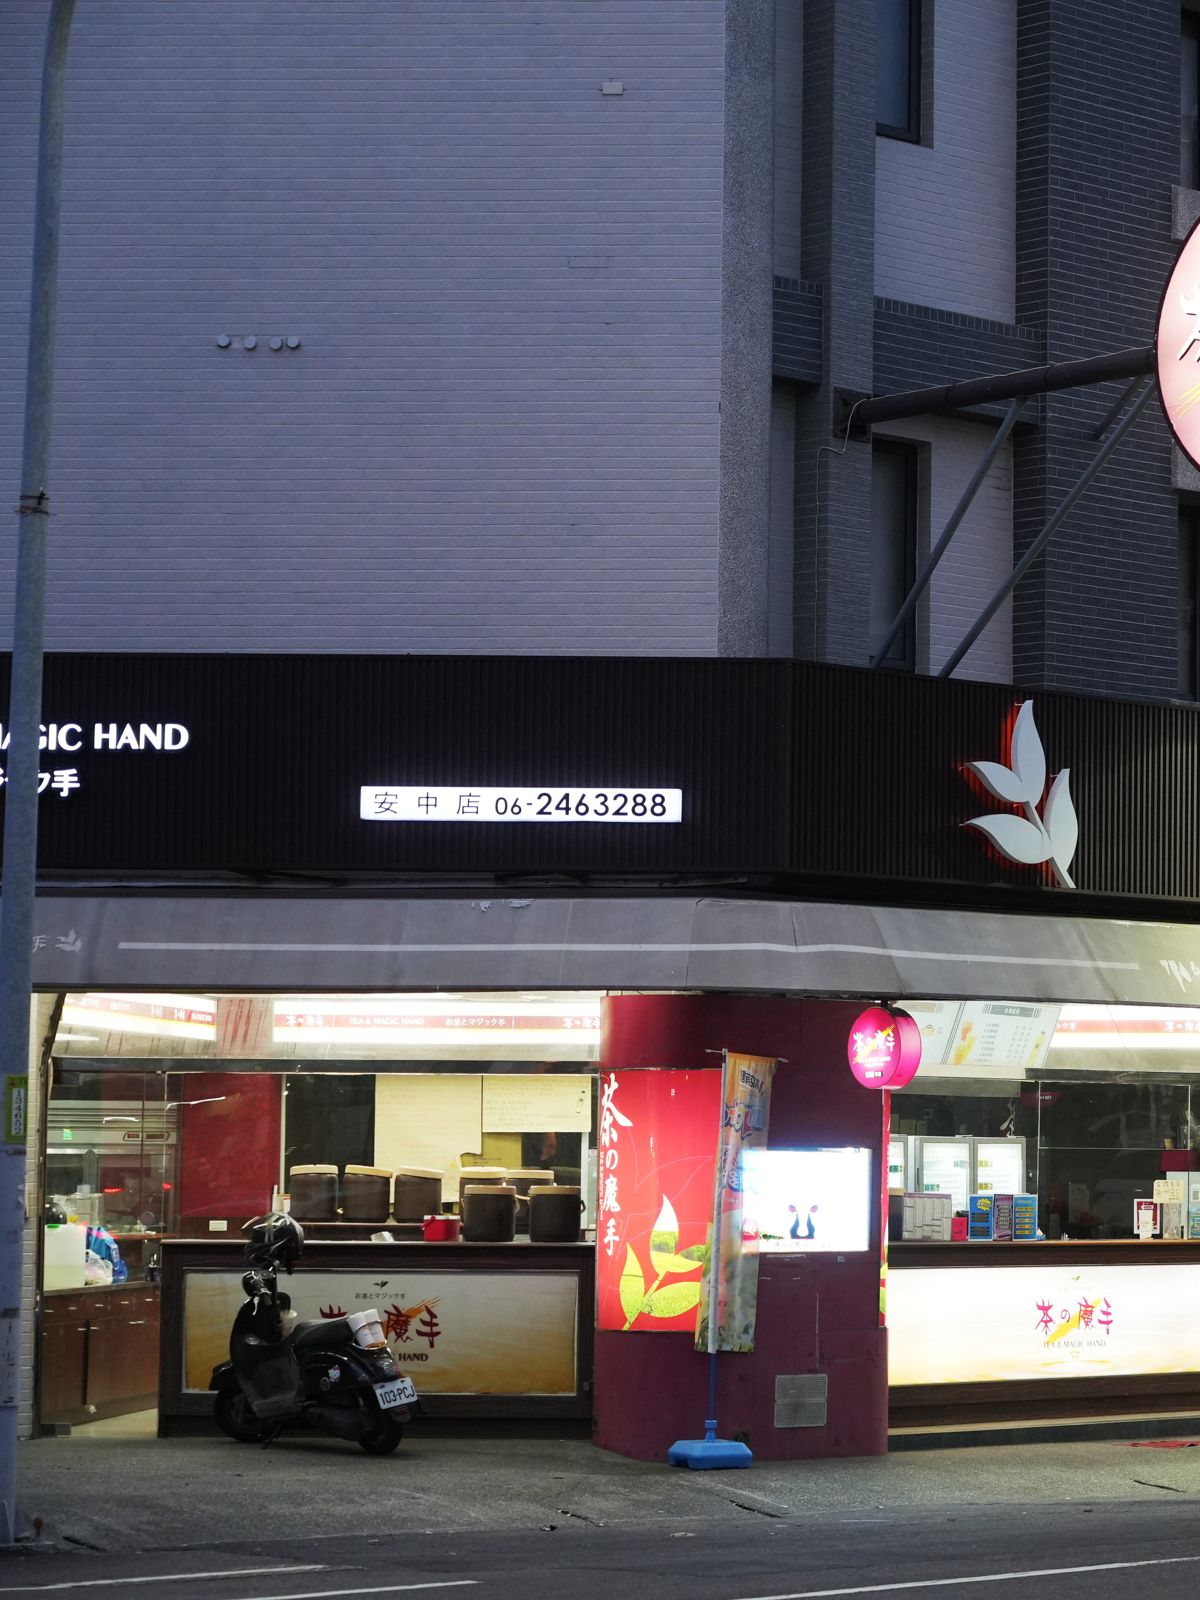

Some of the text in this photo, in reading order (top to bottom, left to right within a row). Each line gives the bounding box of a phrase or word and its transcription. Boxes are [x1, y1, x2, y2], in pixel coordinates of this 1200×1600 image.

[94, 723, 189, 750] HAND
[373, 792, 667, 818] 安中店 06-2463288
[1035, 1296, 1113, 1335] 茶の魔手
[399, 1352, 428, 1362] HAND
[379, 1385, 415, 1405] 103-PCJ
